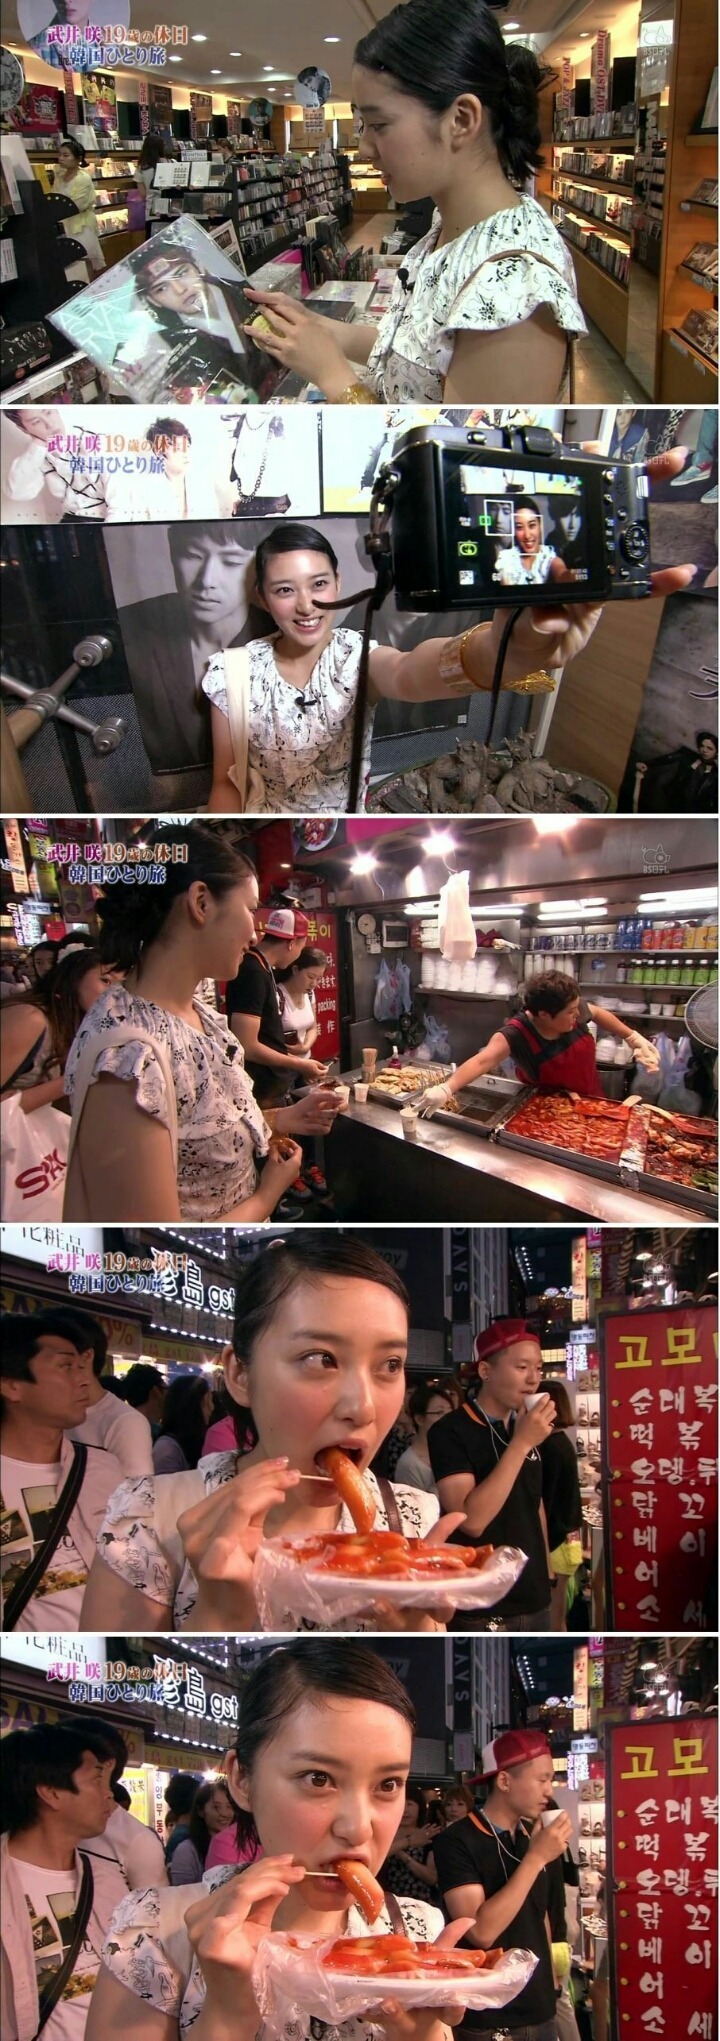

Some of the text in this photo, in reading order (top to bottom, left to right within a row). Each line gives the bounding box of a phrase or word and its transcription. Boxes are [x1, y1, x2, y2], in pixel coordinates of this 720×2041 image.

[597, 29, 607, 66] Drama
[563, 57, 571, 73] POP
[318, 998, 336, 1013] packing
[211, 1692, 239, 1719] gst
[639, 1971, 664, 1999] 어
